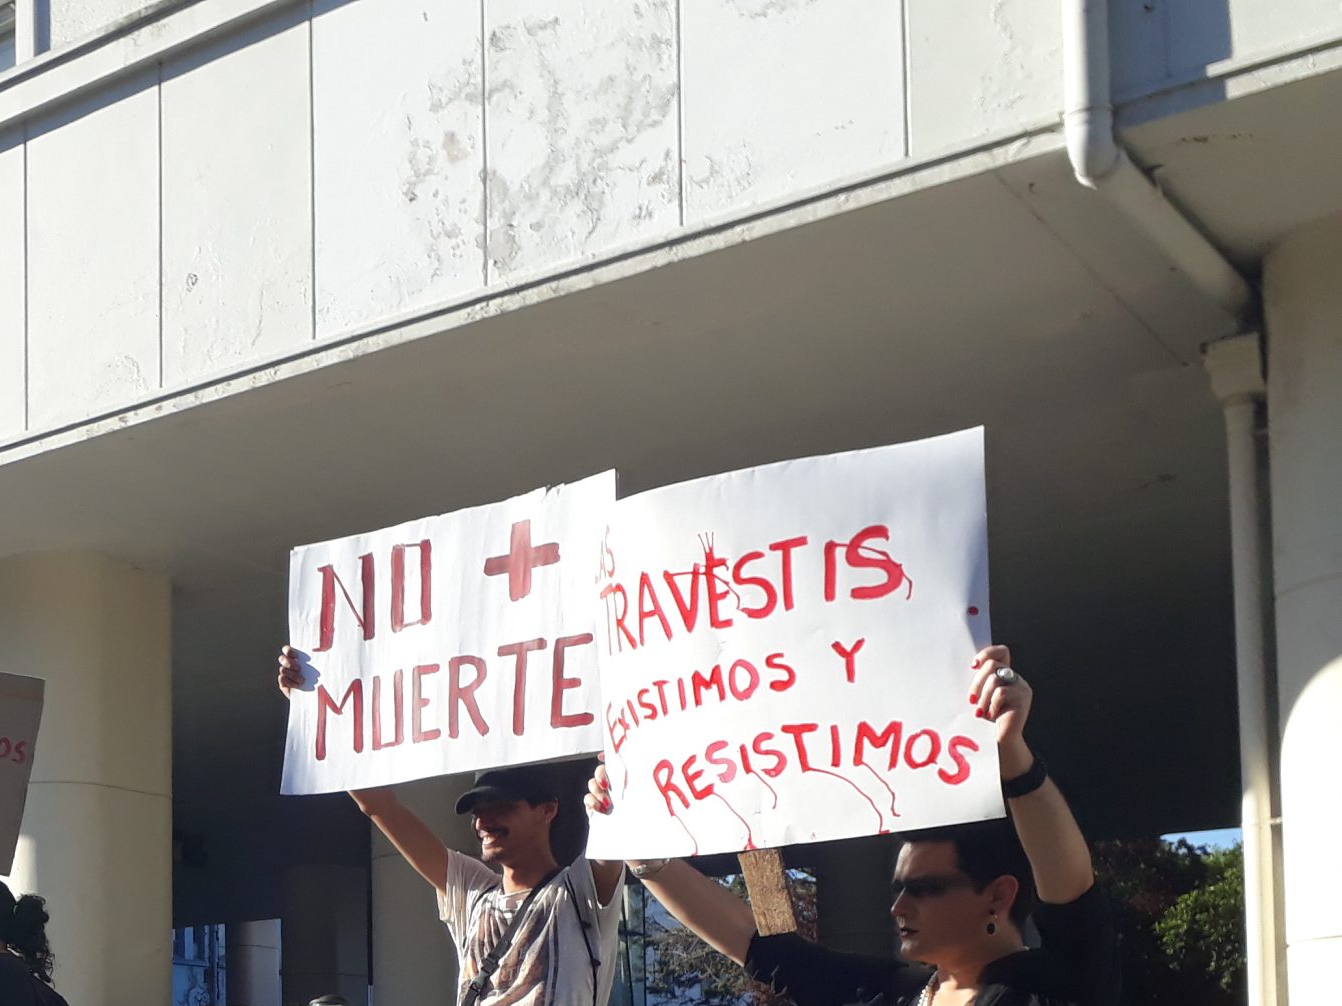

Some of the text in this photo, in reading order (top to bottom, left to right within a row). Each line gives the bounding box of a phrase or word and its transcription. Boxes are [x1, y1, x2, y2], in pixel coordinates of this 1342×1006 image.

[313, 539, 432, 652] NO
[600, 525, 908, 656] TRAVESTIS
[316, 633, 594, 761] MUERTE
[607, 638, 866, 753] EXISTIMOS Y
[653, 721, 979, 817] RESISTIMOS
